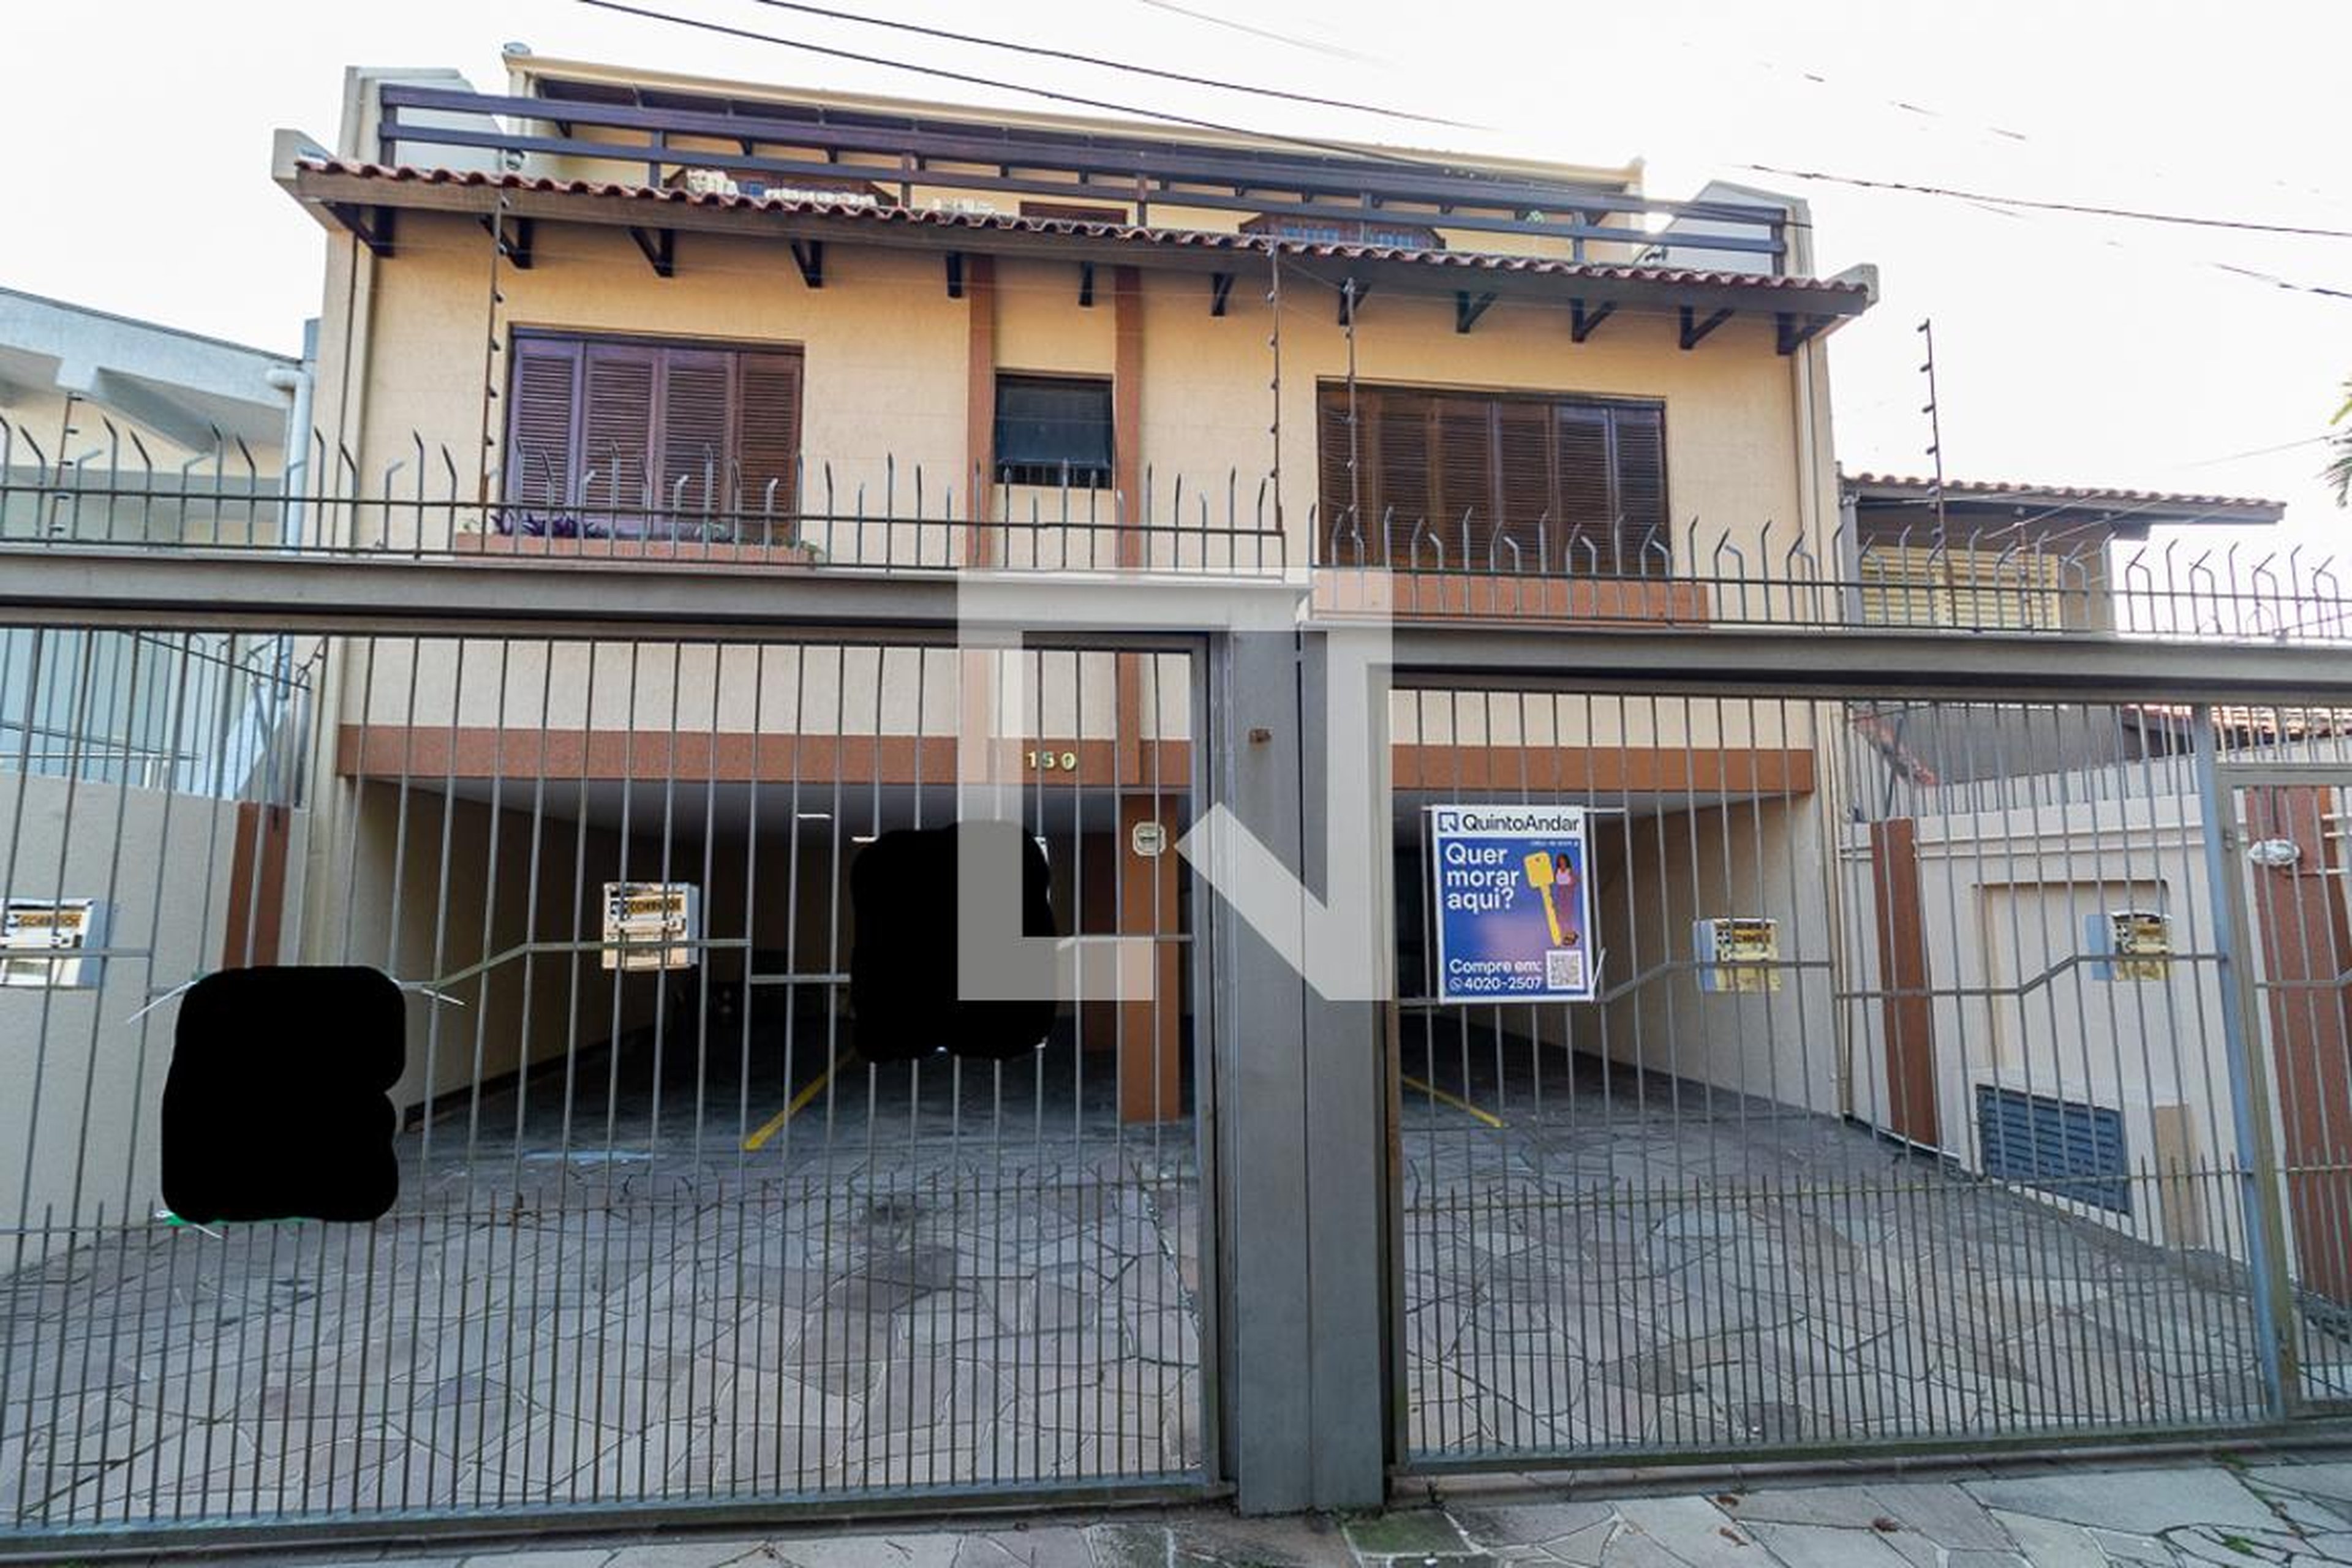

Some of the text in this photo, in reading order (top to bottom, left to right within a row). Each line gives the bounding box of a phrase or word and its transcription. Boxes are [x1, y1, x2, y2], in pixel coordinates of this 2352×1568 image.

[1462, 813, 1579, 832] QuintoAndar
[1446, 842, 1508, 866] Quer
[1446, 870, 1520, 887] morar
[1447, 887, 1515, 914] aqui?
[1449, 959, 1512, 975] Compre
[1464, 977, 1542, 990] 4020-2507
